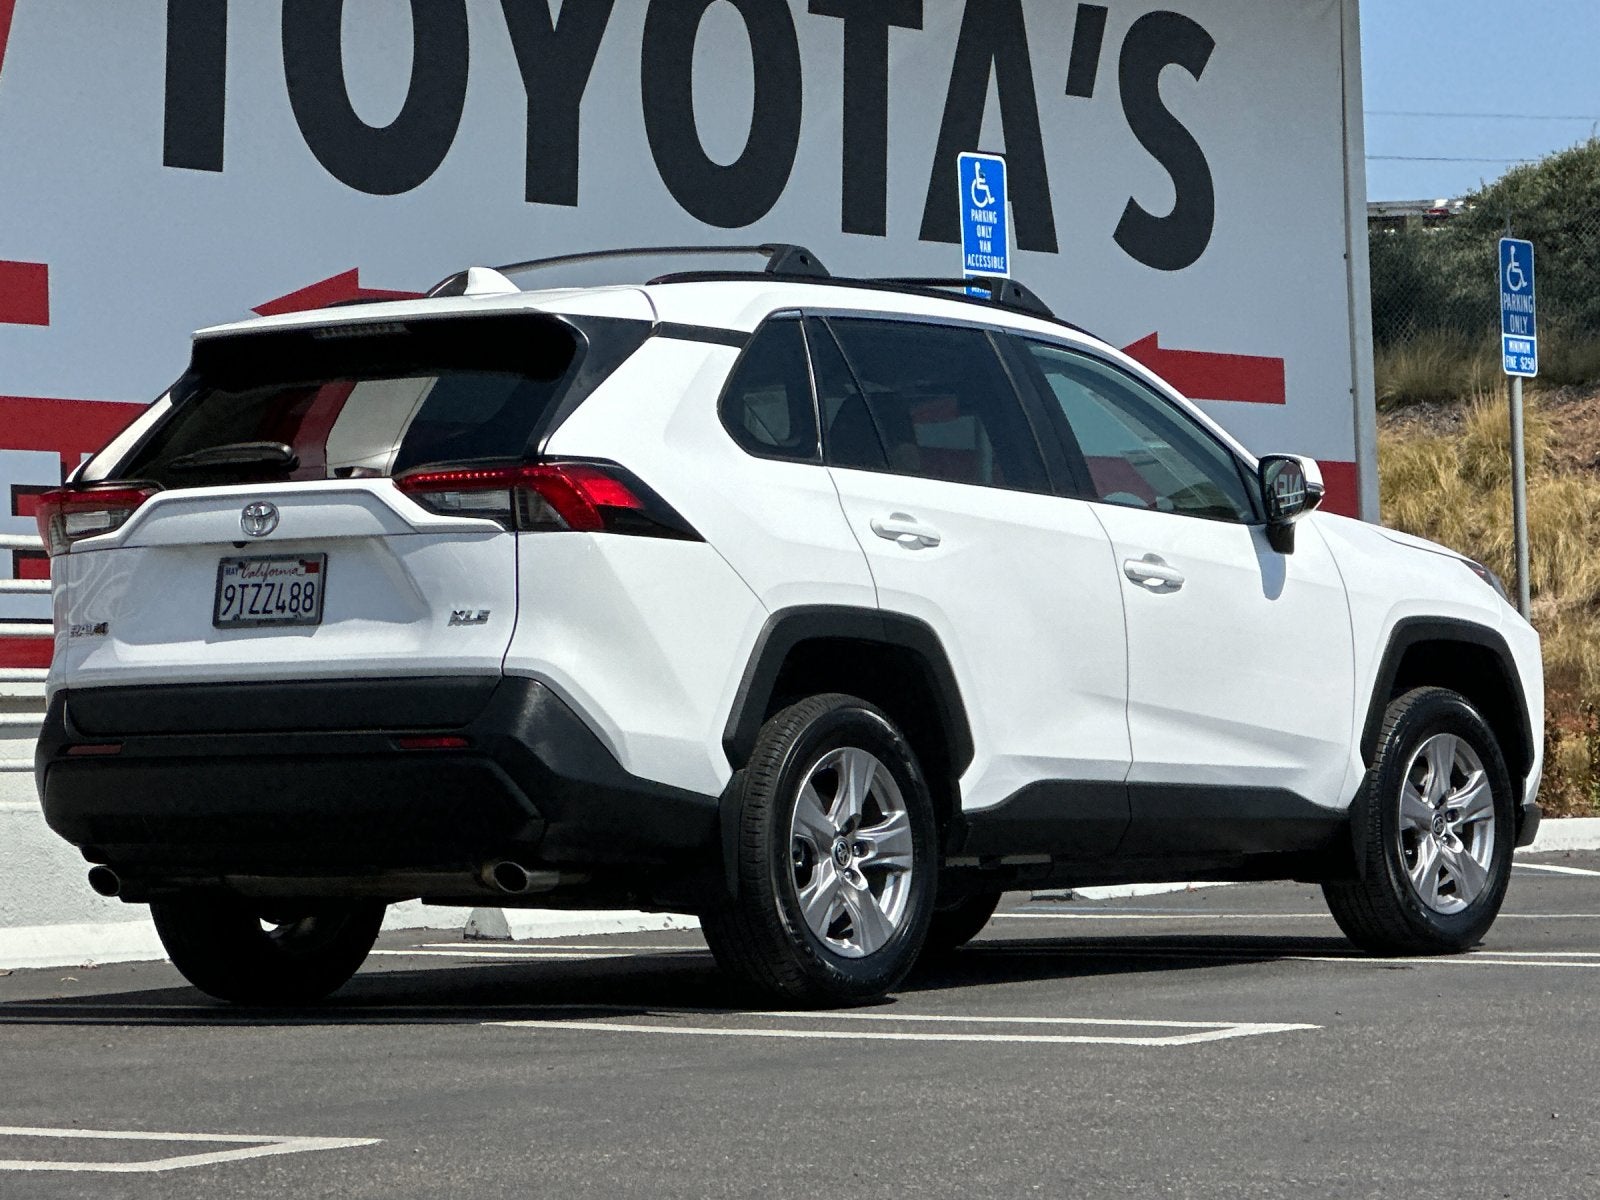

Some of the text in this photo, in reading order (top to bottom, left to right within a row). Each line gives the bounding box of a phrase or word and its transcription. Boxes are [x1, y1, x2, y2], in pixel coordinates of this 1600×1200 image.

[971, 209, 997, 224] PARKING
[977, 225, 993, 238] ONLY
[979, 240, 991, 253] VAN
[967, 254, 1004, 270] ACCESSIBLE
[1503, 292, 1533, 314] PARKING
[1510, 314, 1528, 334] ONLY
[1509, 340, 1531, 355] MINIMUM
[1506, 355, 1518, 369] FINE
[241, 560, 300, 582] California
[221, 581, 315, 616] 9TZZ488
[447, 609, 491, 627] XLE
